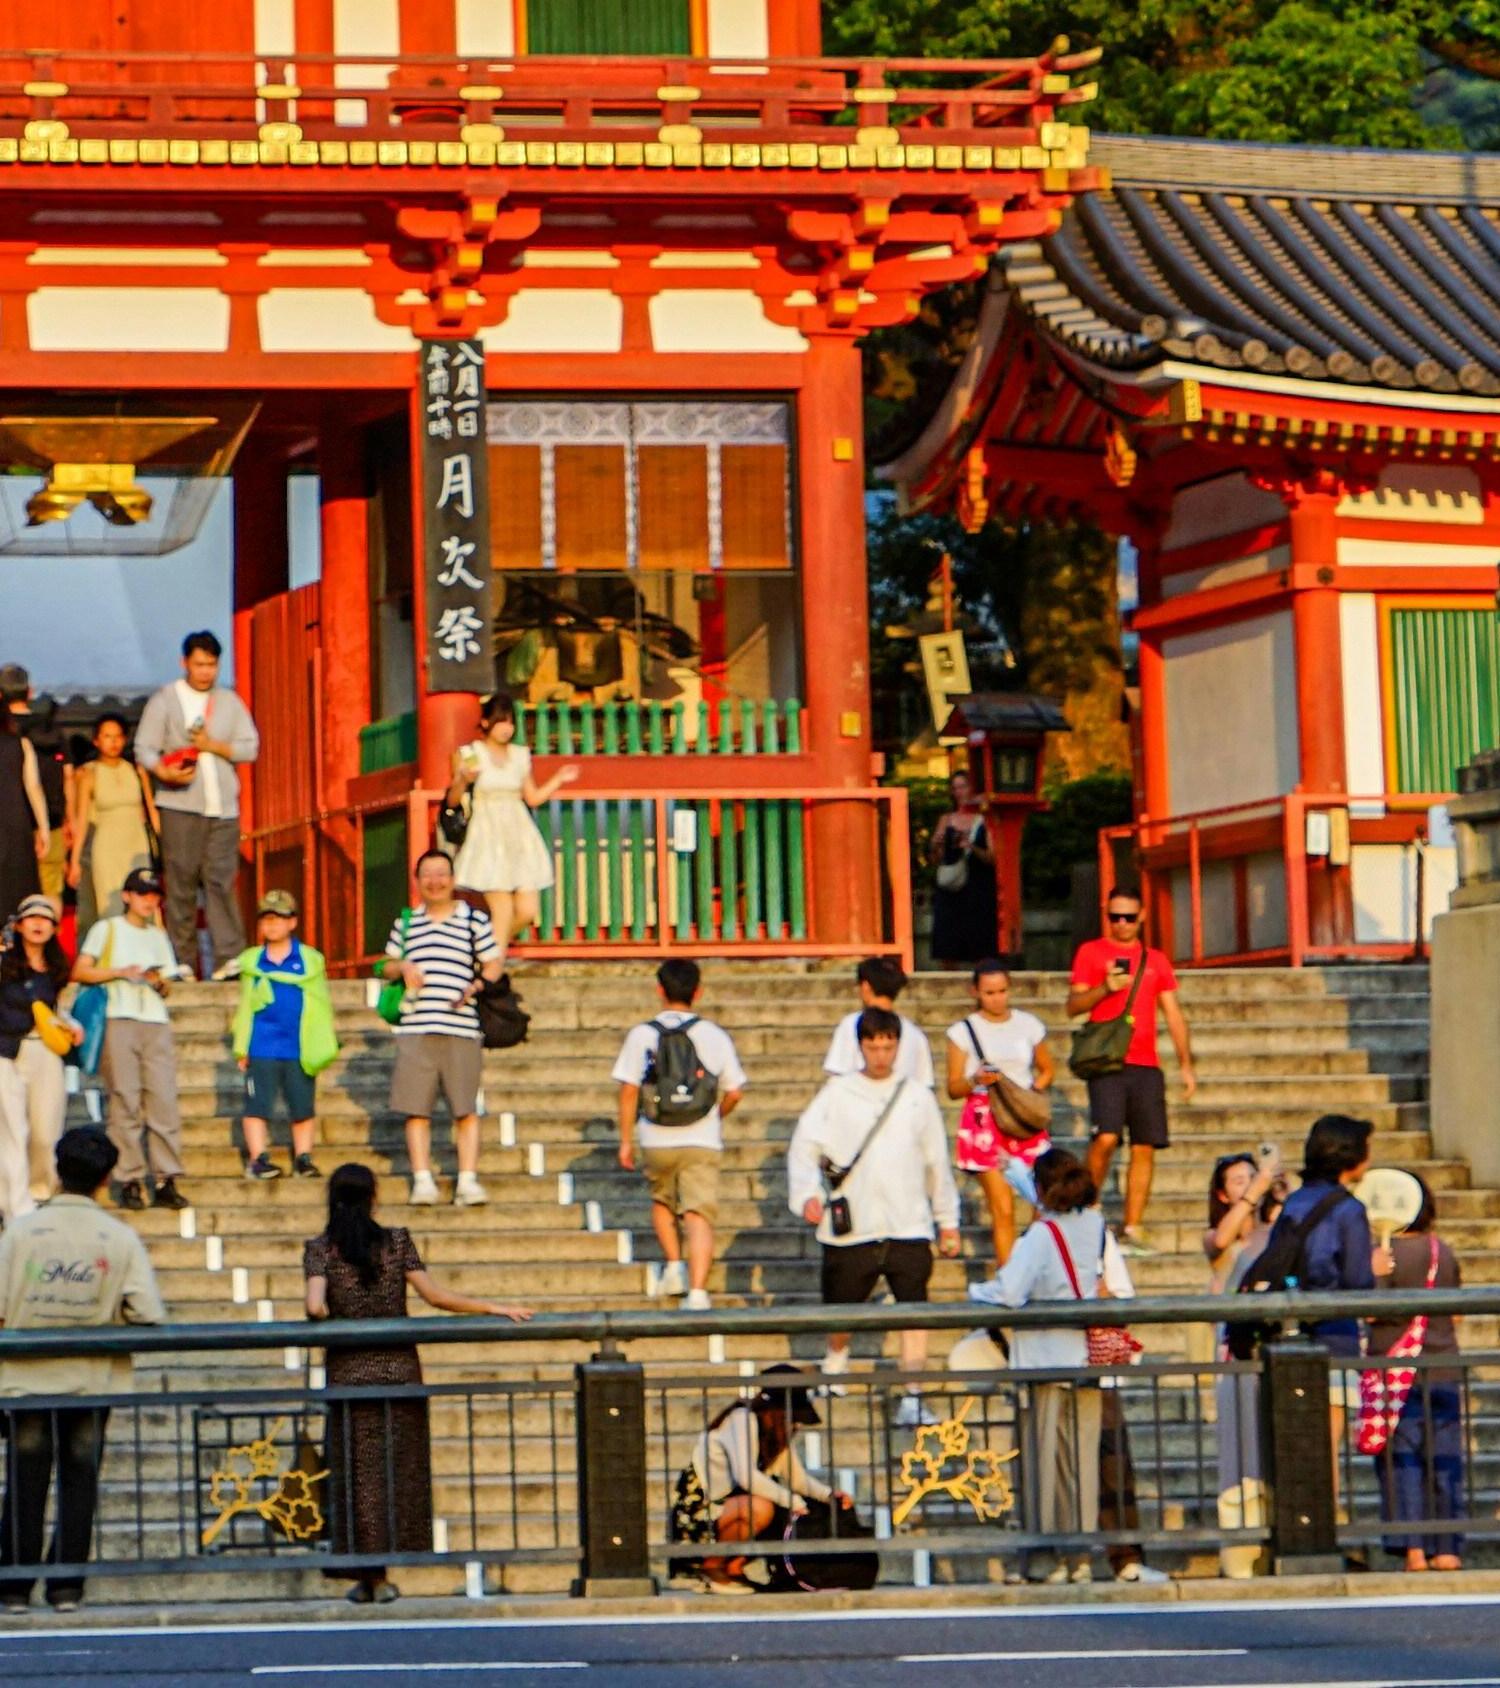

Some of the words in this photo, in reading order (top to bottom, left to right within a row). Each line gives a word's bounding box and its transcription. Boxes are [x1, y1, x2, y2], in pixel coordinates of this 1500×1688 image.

[450, 342, 485, 437] 八月一日
[434, 453, 485, 662] 月次祭
